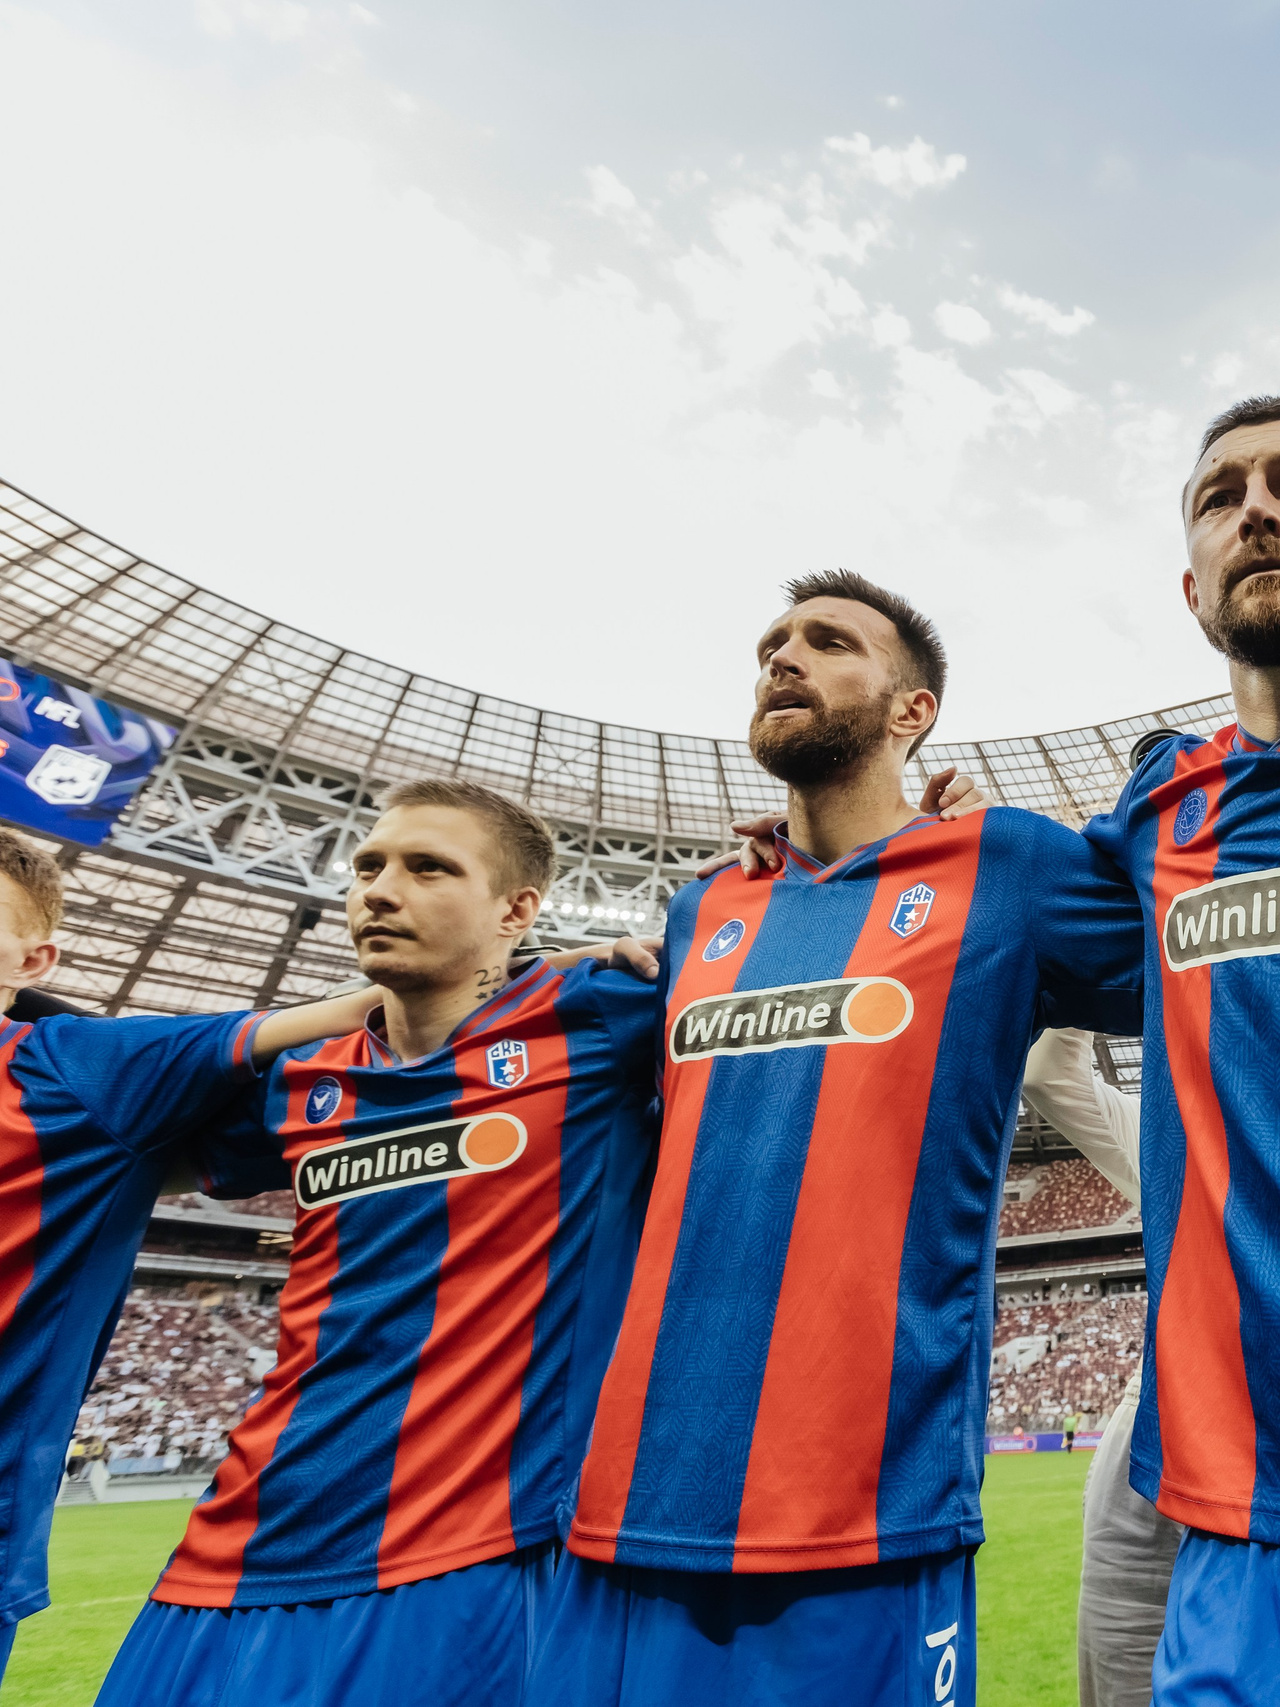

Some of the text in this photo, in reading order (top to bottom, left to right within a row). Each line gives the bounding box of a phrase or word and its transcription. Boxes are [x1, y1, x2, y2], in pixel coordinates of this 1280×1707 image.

[474, 965, 503, 987] 22
[685, 1001, 831, 1045] Winline
[306, 1142, 449, 1194] Winline
